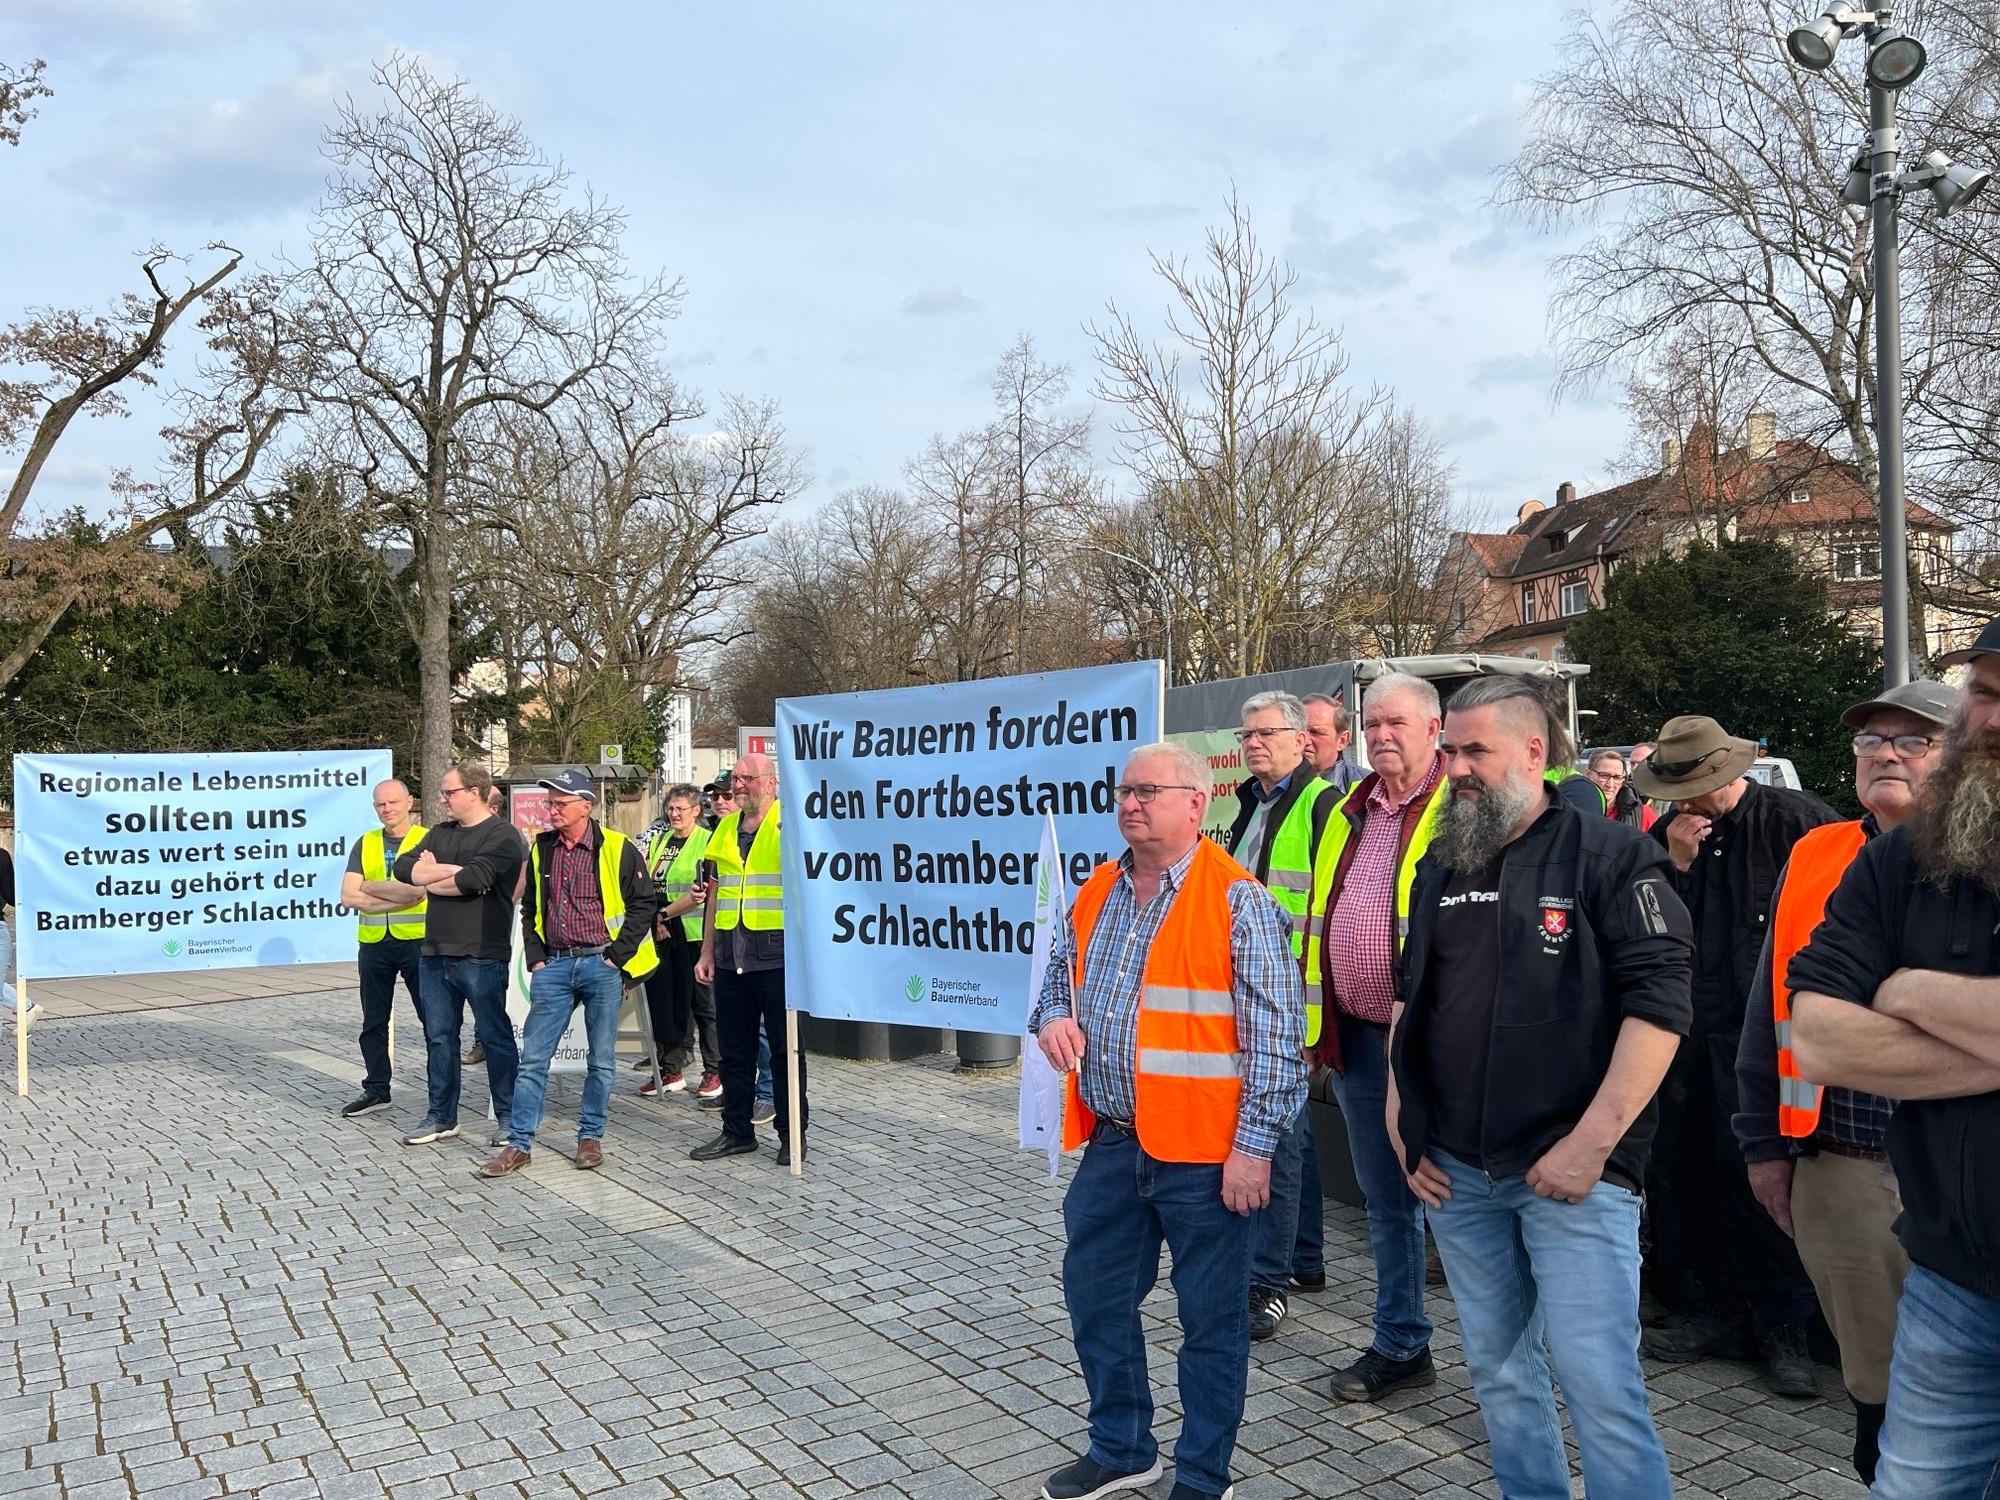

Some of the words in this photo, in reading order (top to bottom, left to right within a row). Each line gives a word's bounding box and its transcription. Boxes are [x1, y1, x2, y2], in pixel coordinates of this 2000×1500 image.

[792, 720, 844, 761] Wir
[852, 720, 975, 758] Bauern
[986, 700, 1137, 751] fordern
[39, 771, 182, 798] Regionale
[192, 767, 367, 791] Lebensmittel
[805, 780, 866, 820] den
[876, 766, 1116, 819] Fortbestand
[105, 805, 233, 834] sollten
[246, 808, 307, 830] uns
[64, 846, 150, 866] etwas
[160, 843, 225, 863] wert
[234, 839, 288, 861] sein
[297, 837, 345, 858] und
[803, 851, 883, 882] vom
[95, 875, 161, 897] dazu
[171, 871, 264, 900] gehört
[273, 869, 317, 889] der
[36, 906, 194, 932] Bamberger
[831, 902, 1036, 956] Schlachtho
[187, 938, 236, 948] Bayerischer
[188, 945, 253, 956] BauernVerband
[930, 991, 999, 1007] BauernVerband
[931, 977, 982, 992] Bayerischer
